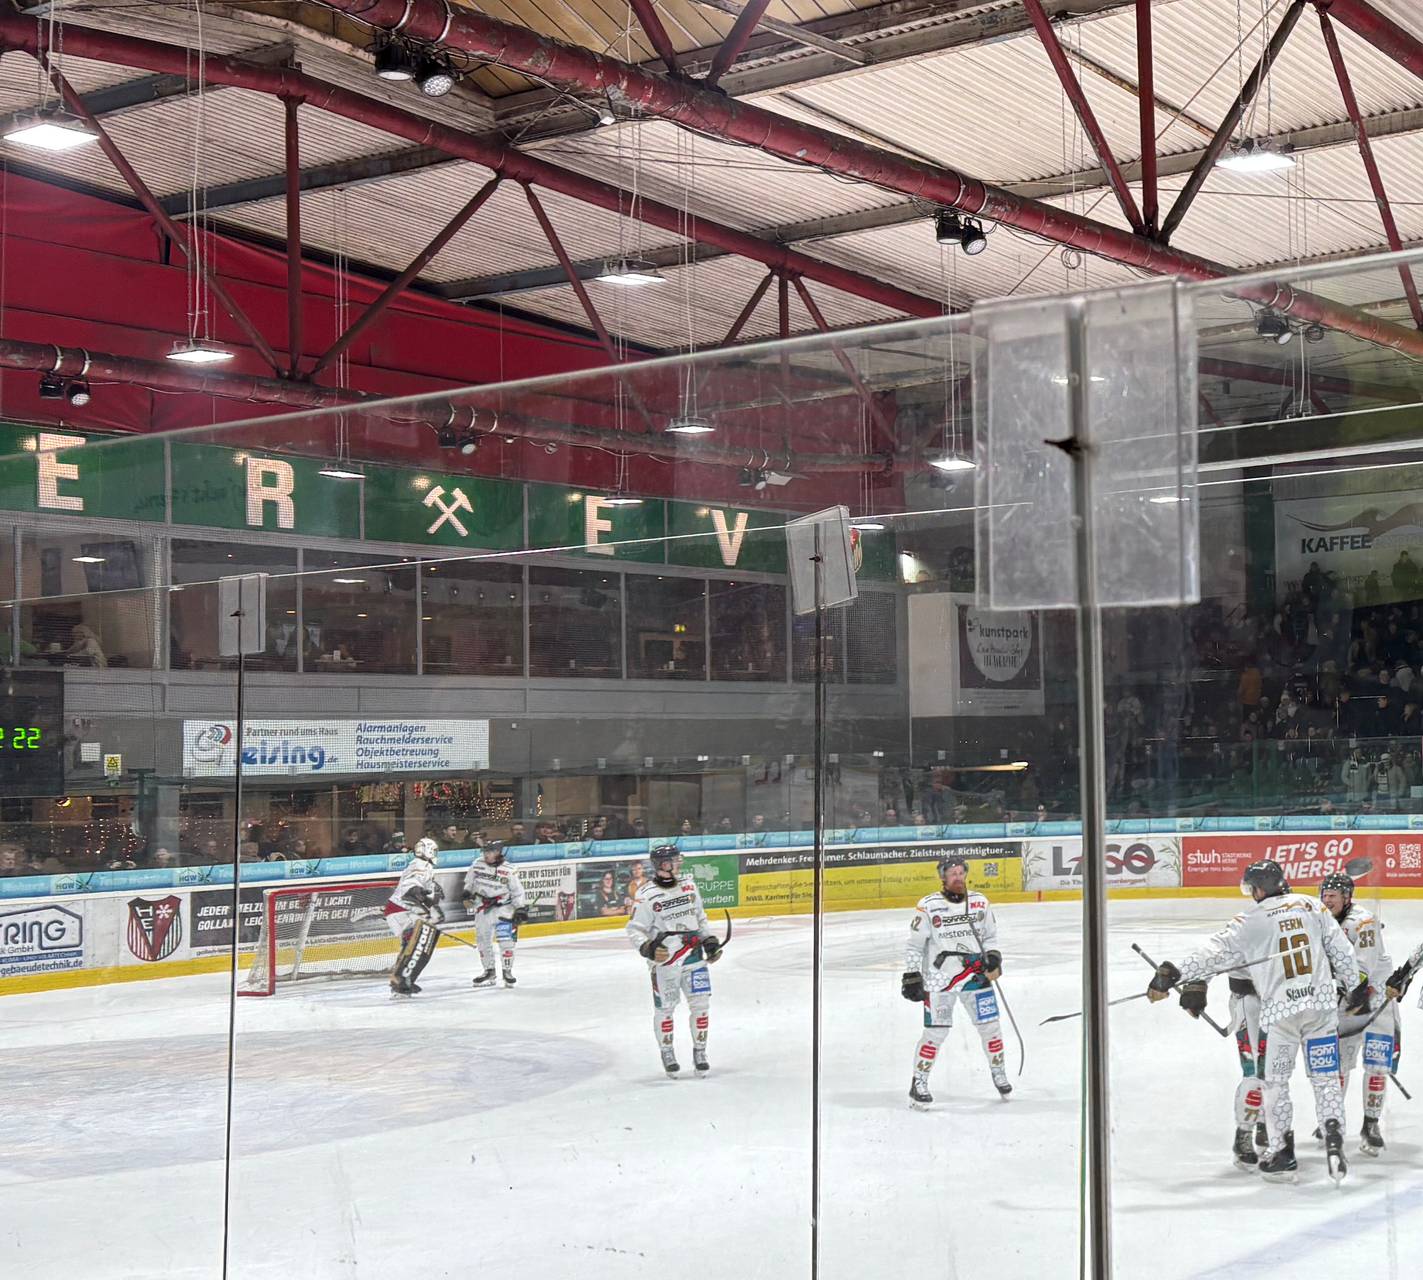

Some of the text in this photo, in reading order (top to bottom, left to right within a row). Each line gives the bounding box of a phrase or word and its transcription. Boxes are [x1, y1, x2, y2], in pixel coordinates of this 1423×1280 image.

[36, 433, 85, 511] E
[244, 457, 295, 529] R
[584, 494, 616, 555] E
[710, 508, 748, 566] V
[1300, 533, 1373, 554] KAFFEE
[979, 624, 1029, 641] kunstpark
[355, 722, 427, 735] Alarmanlagen
[355, 734, 454, 746] Rauchmelderservice
[355, 746, 440, 759] Objektbetreuung
[354, 758, 451, 770] Hausmeisterservice
[1324, 837, 1354, 858] GO
[746, 856, 798, 867] Mehrdenker.
[848, 849, 908, 860] Schlaumacher.
[910, 846, 956, 858] Zielstreber.
[957, 845, 1003, 856] Richtigtuer
[1187, 849, 1221, 864] stwh
[540, 866, 559, 878] STEHT
[559, 865, 572, 877] FÜR
[699, 880, 735, 891] RUPPE
[197, 905, 229, 918] JEDER
[1358, 928, 1376, 948] 33
[1279, 934, 1313, 980] 10
